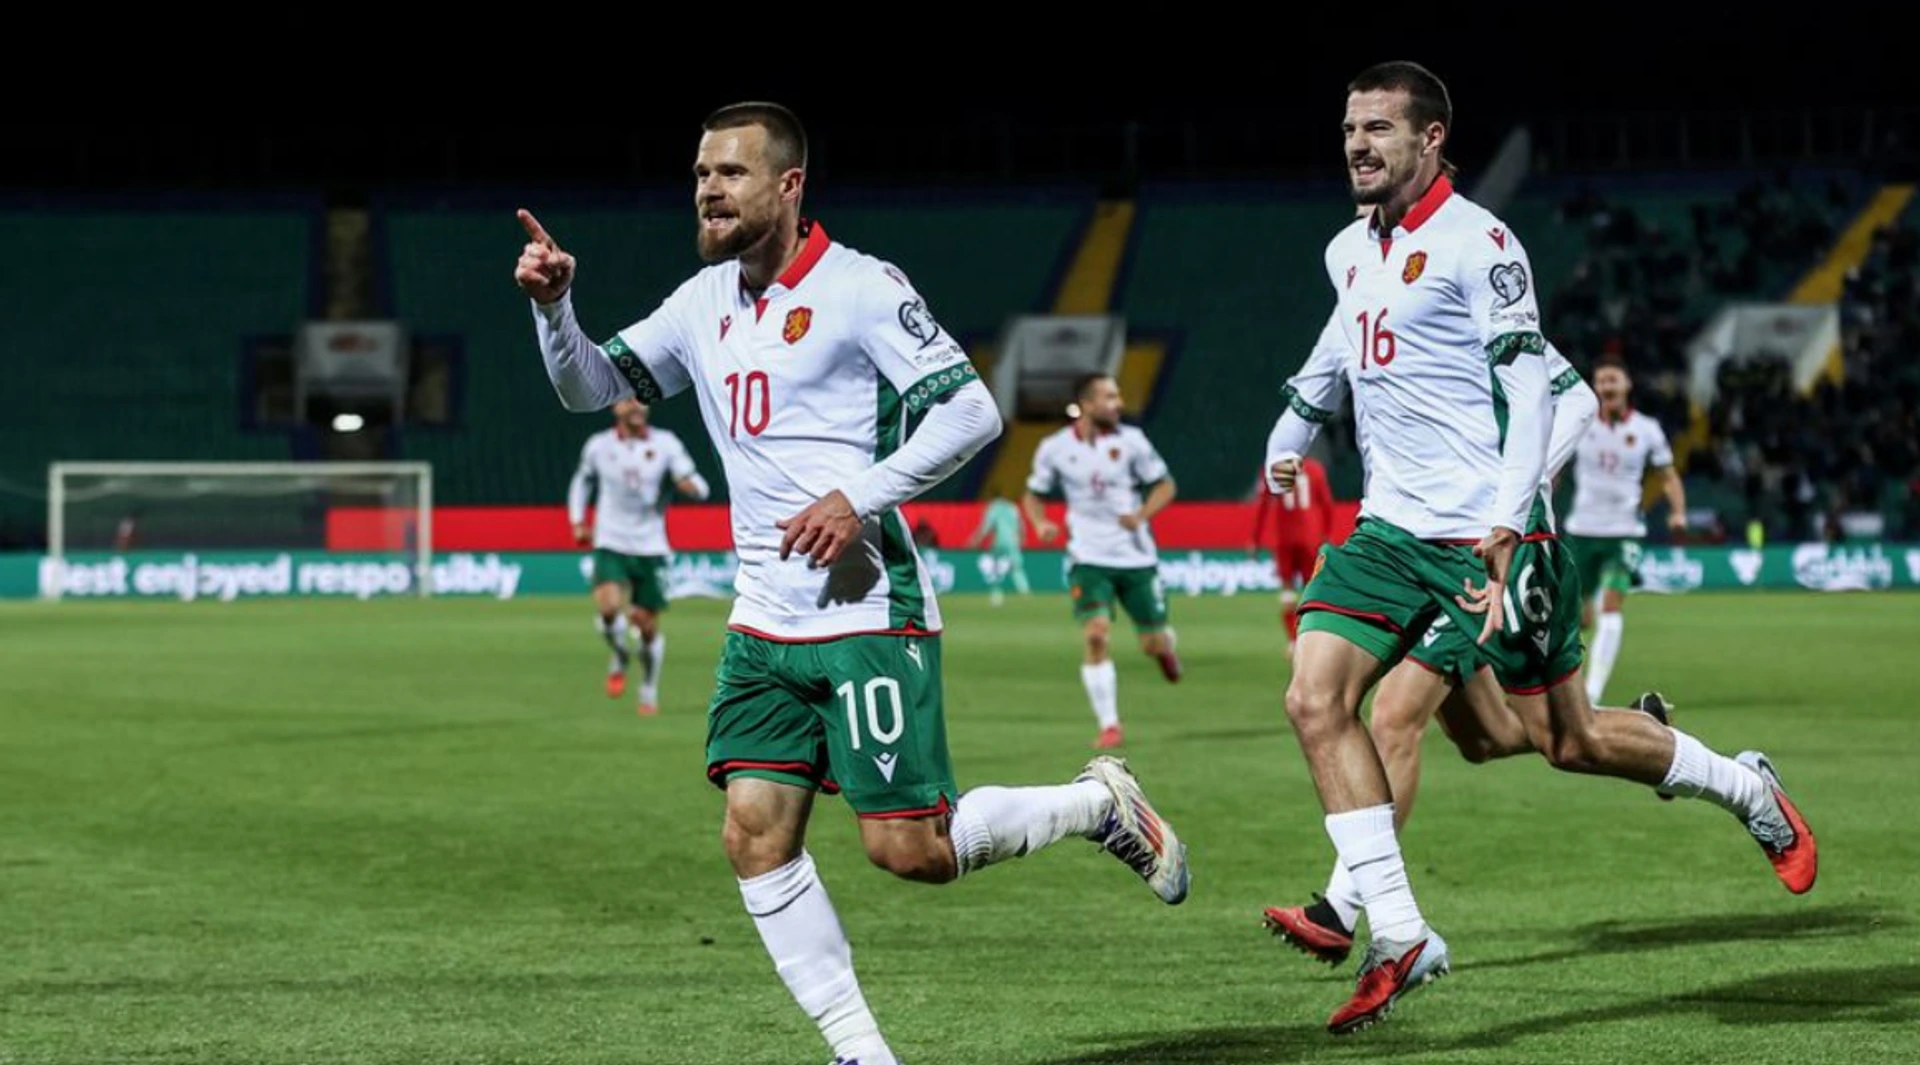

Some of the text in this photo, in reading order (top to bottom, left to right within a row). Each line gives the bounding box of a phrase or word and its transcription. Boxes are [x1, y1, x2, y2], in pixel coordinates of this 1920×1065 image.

[1356, 307, 1395, 370] 16
[724, 370, 771, 439] 10
[133, 552, 292, 601] enjoyed
[298, 552, 523, 601] resposibly
[1502, 562, 1554, 634] 16
[837, 676, 904, 751] 10
